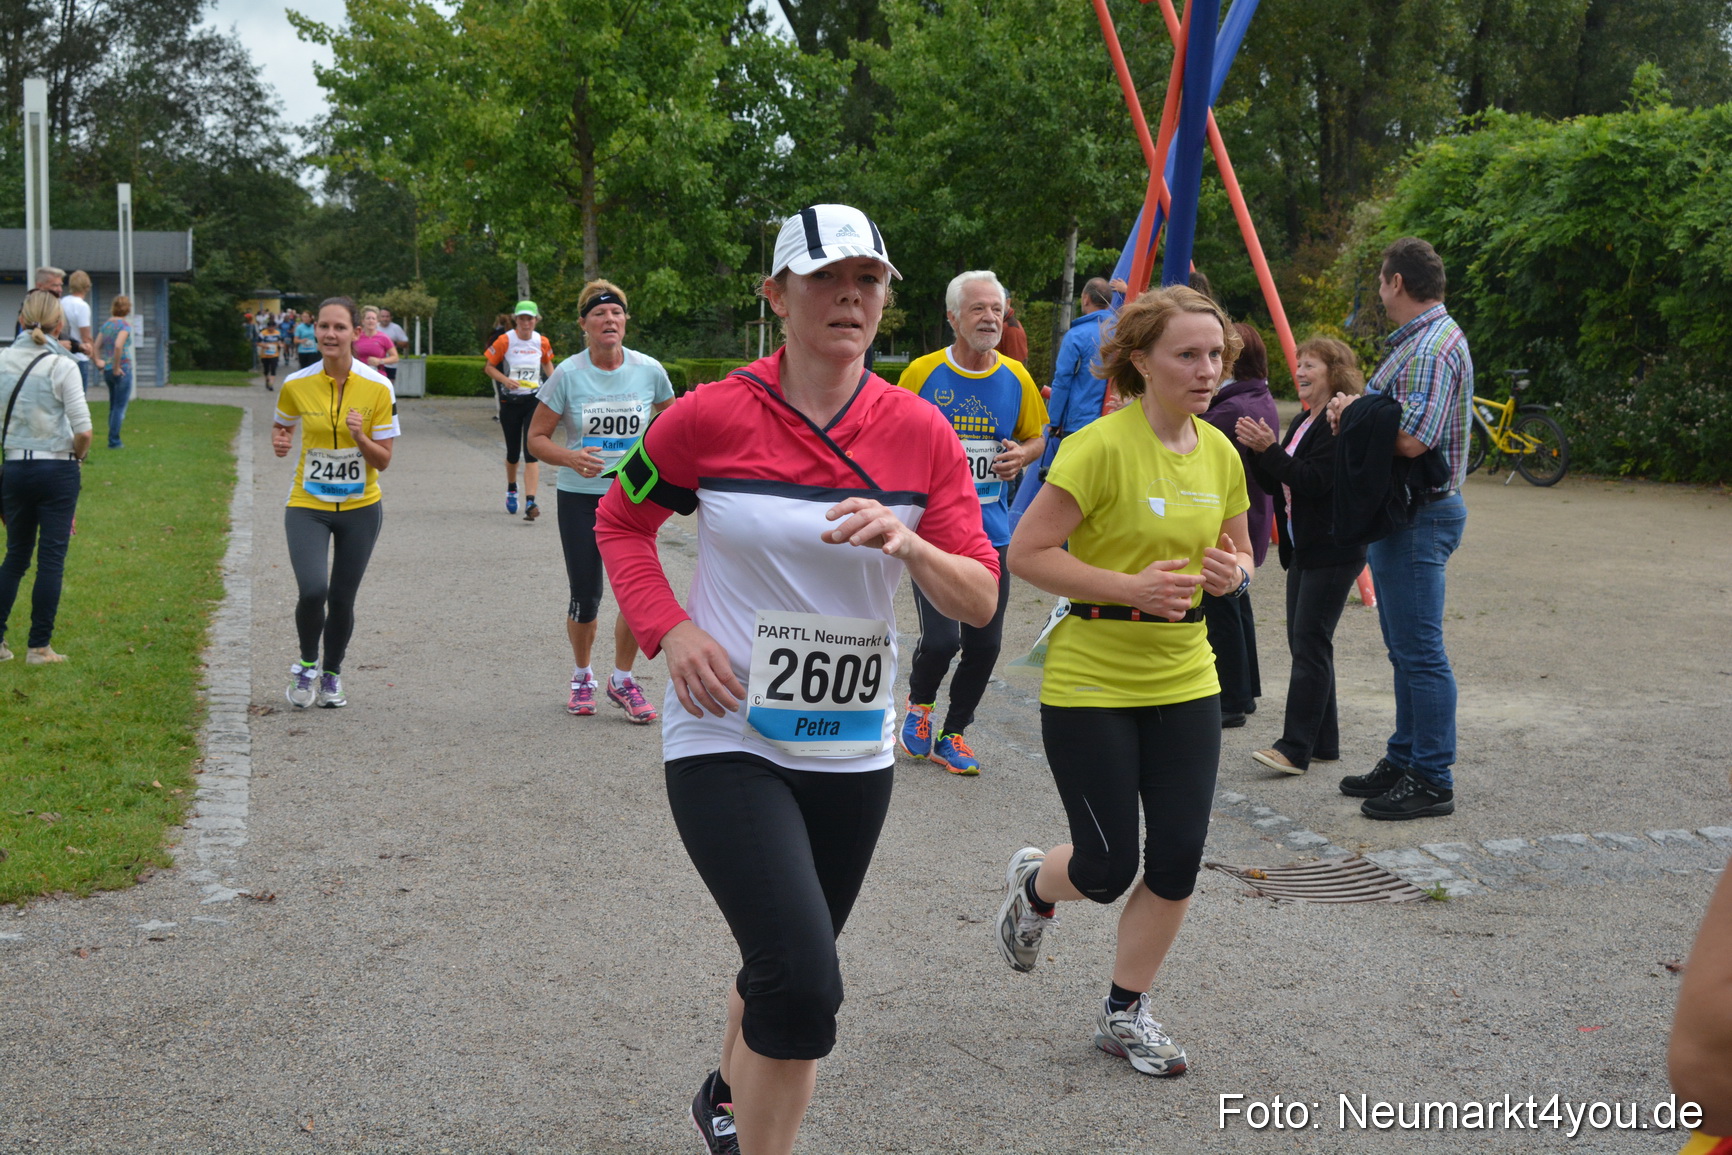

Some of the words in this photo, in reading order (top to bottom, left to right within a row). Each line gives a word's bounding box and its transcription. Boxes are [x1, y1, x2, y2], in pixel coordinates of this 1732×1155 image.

[517, 370, 535, 380] 127
[589, 414, 640, 436] 2909
[602, 440, 624, 448] Karin
[310, 460, 360, 480] 2446
[320, 485, 348, 494] Sabine
[976, 486, 990, 495] und
[757, 624, 810, 641] PARTL
[814, 630, 882, 647] Neumarkt
[766, 648, 882, 704] 2609
[794, 717, 840, 736] Petra
